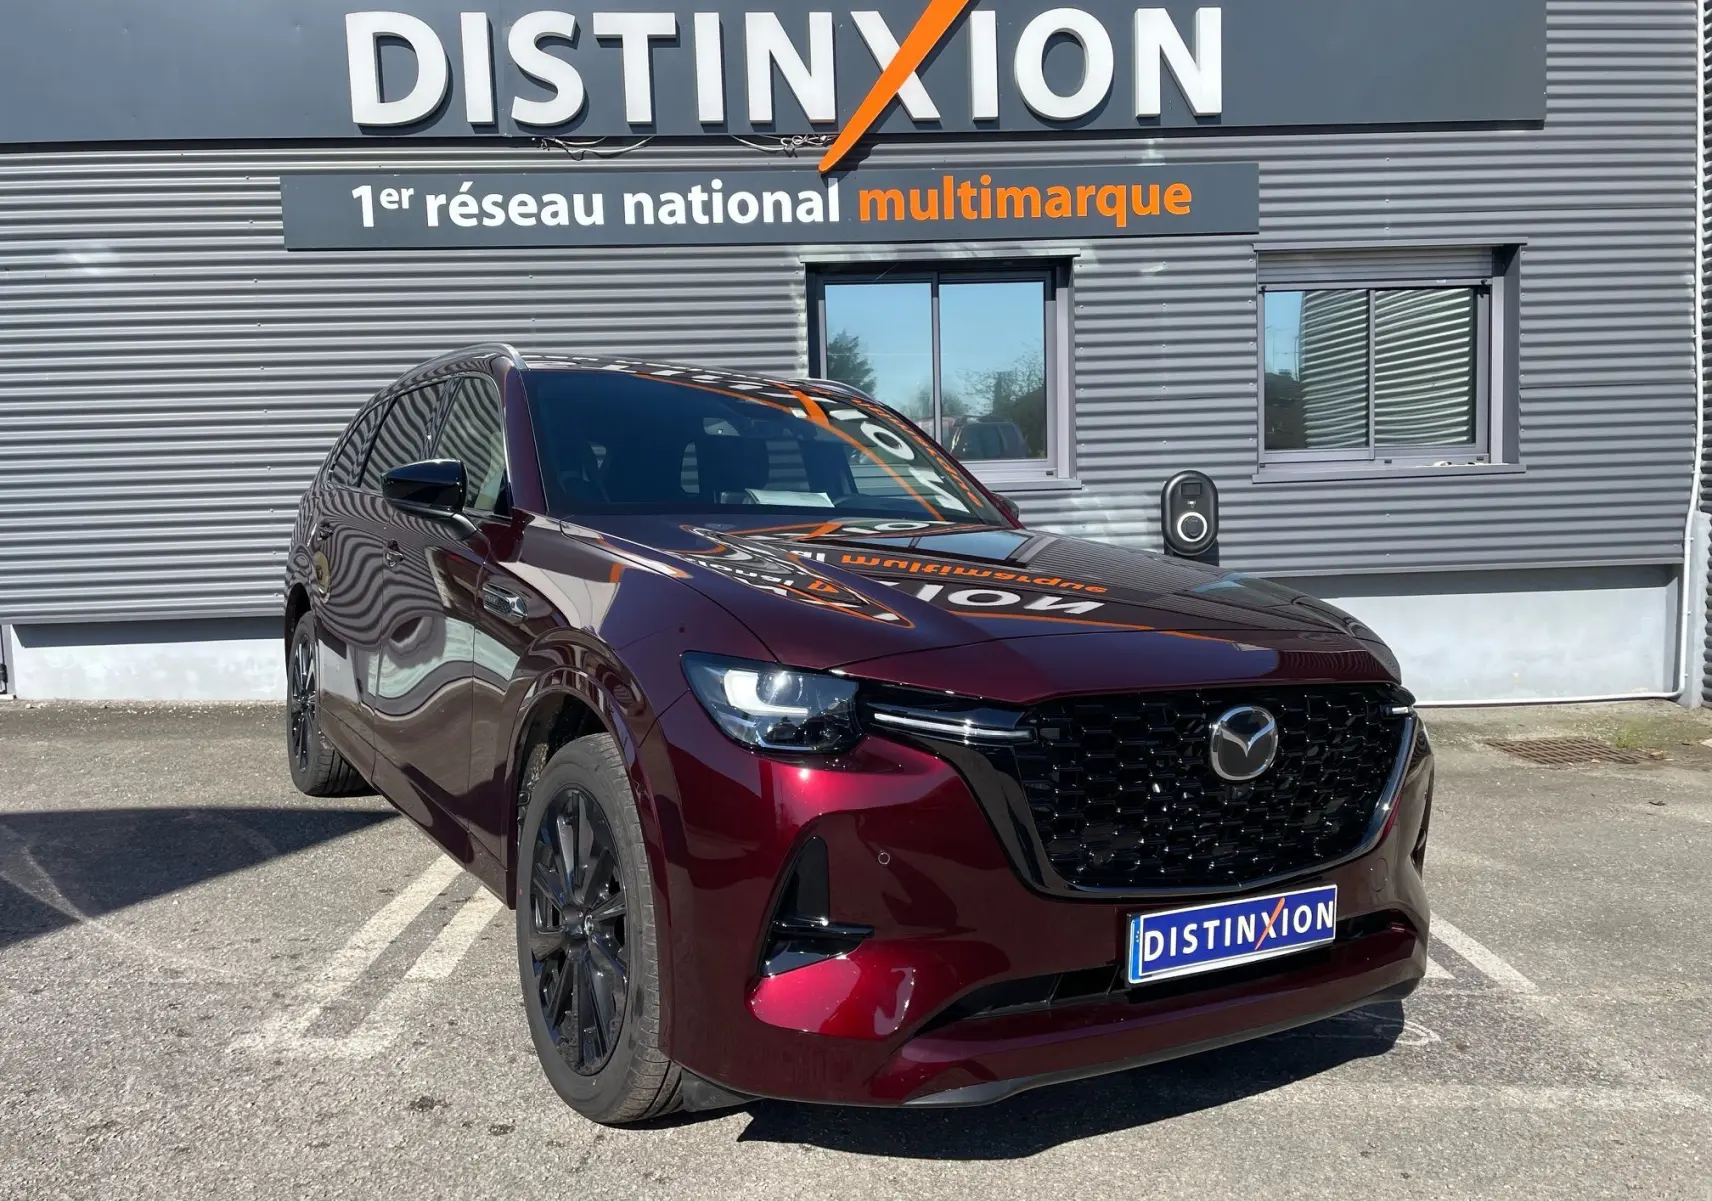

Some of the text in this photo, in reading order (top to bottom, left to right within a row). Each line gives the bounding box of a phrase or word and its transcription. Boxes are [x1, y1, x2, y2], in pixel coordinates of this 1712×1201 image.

[345, 0, 1223, 172] DISTINXION
[351, 174, 1193, 229] 1er réseau national multimarque
[1143, 897, 1334, 962] DISTINXION
